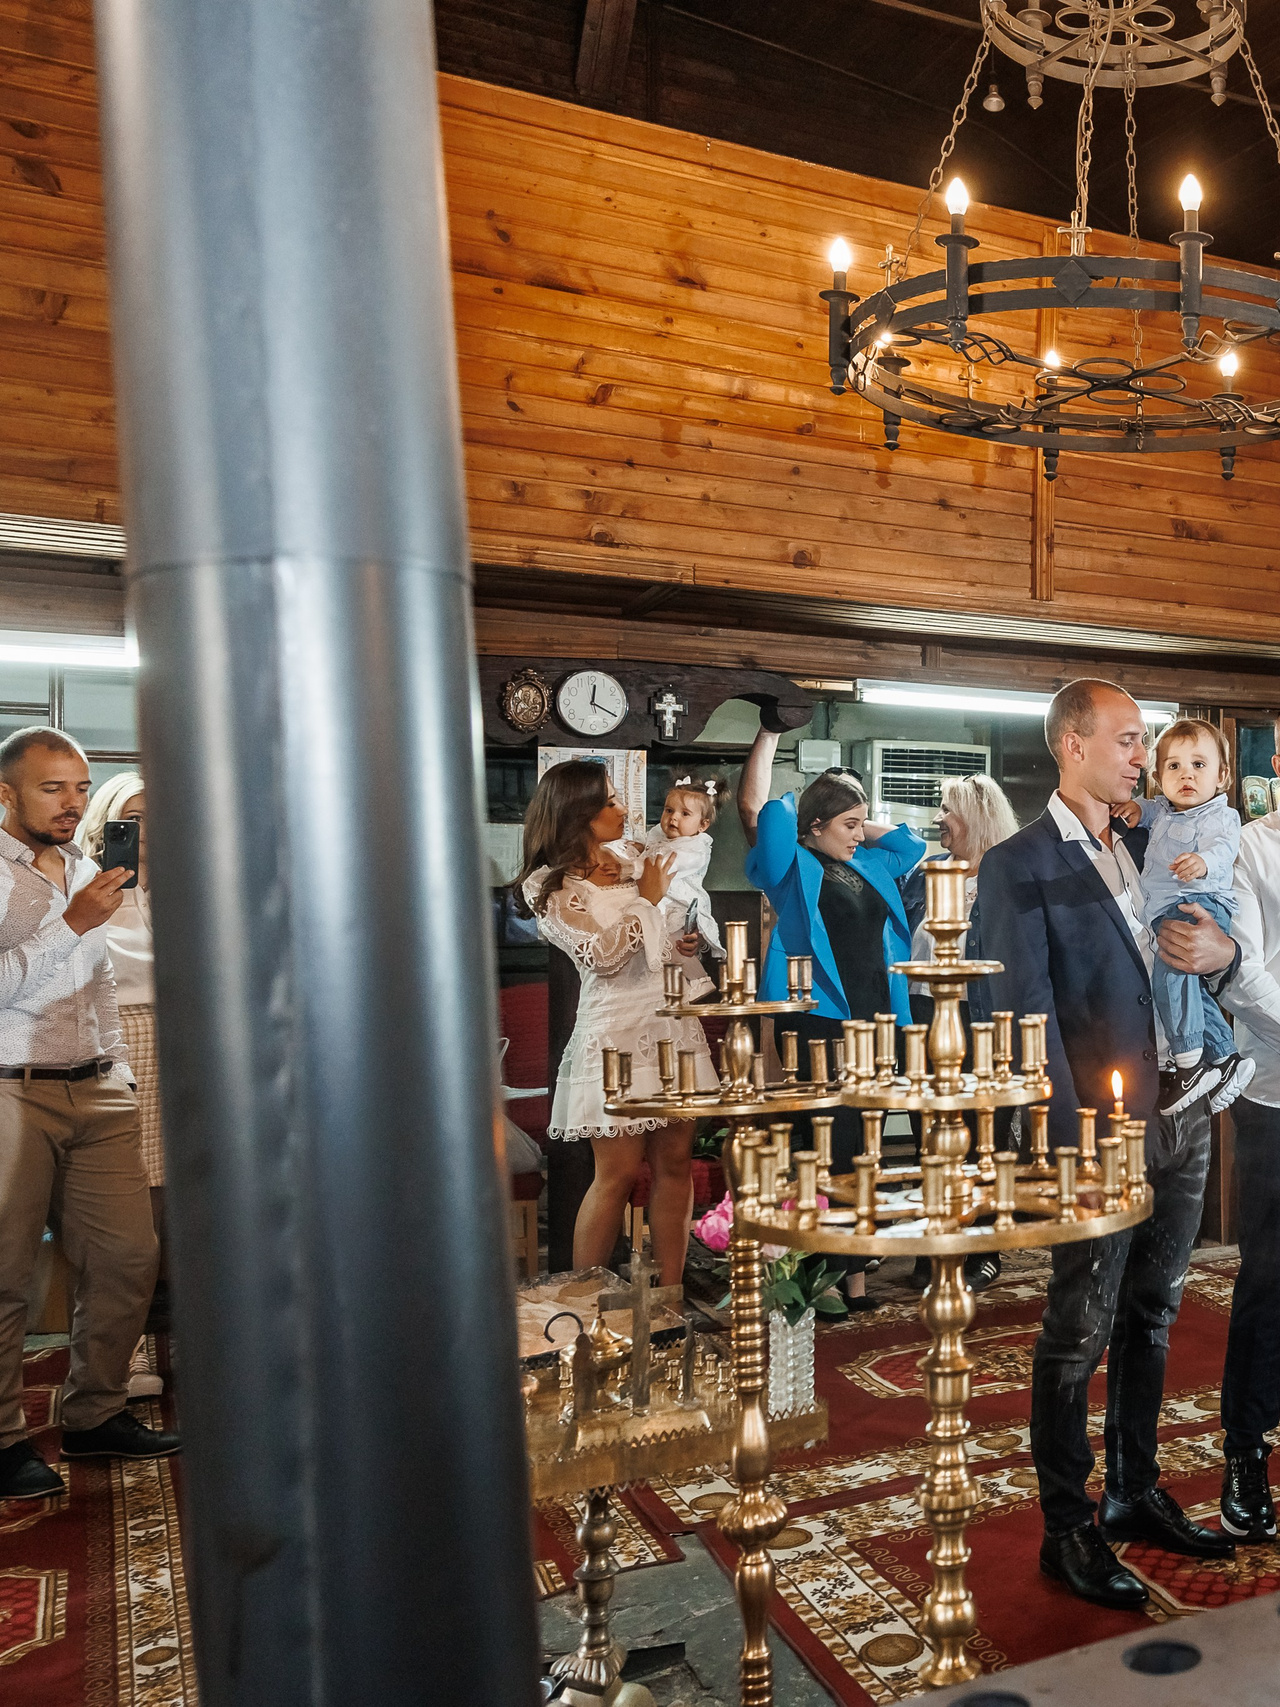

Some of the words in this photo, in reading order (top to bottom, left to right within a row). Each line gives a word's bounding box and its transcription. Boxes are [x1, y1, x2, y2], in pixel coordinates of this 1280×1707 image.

[577, 678, 583, 687] 11
[587, 675, 597, 686] 12
[567, 686, 578, 697] 10
[609, 686, 616, 696] 2
[563, 698, 570, 708] 9
[615, 699, 620, 708] 3
[568, 709, 575, 720] 8
[578, 718, 585, 729] 7
[589, 721, 597, 731] 6
[602, 718, 609, 729] 5
